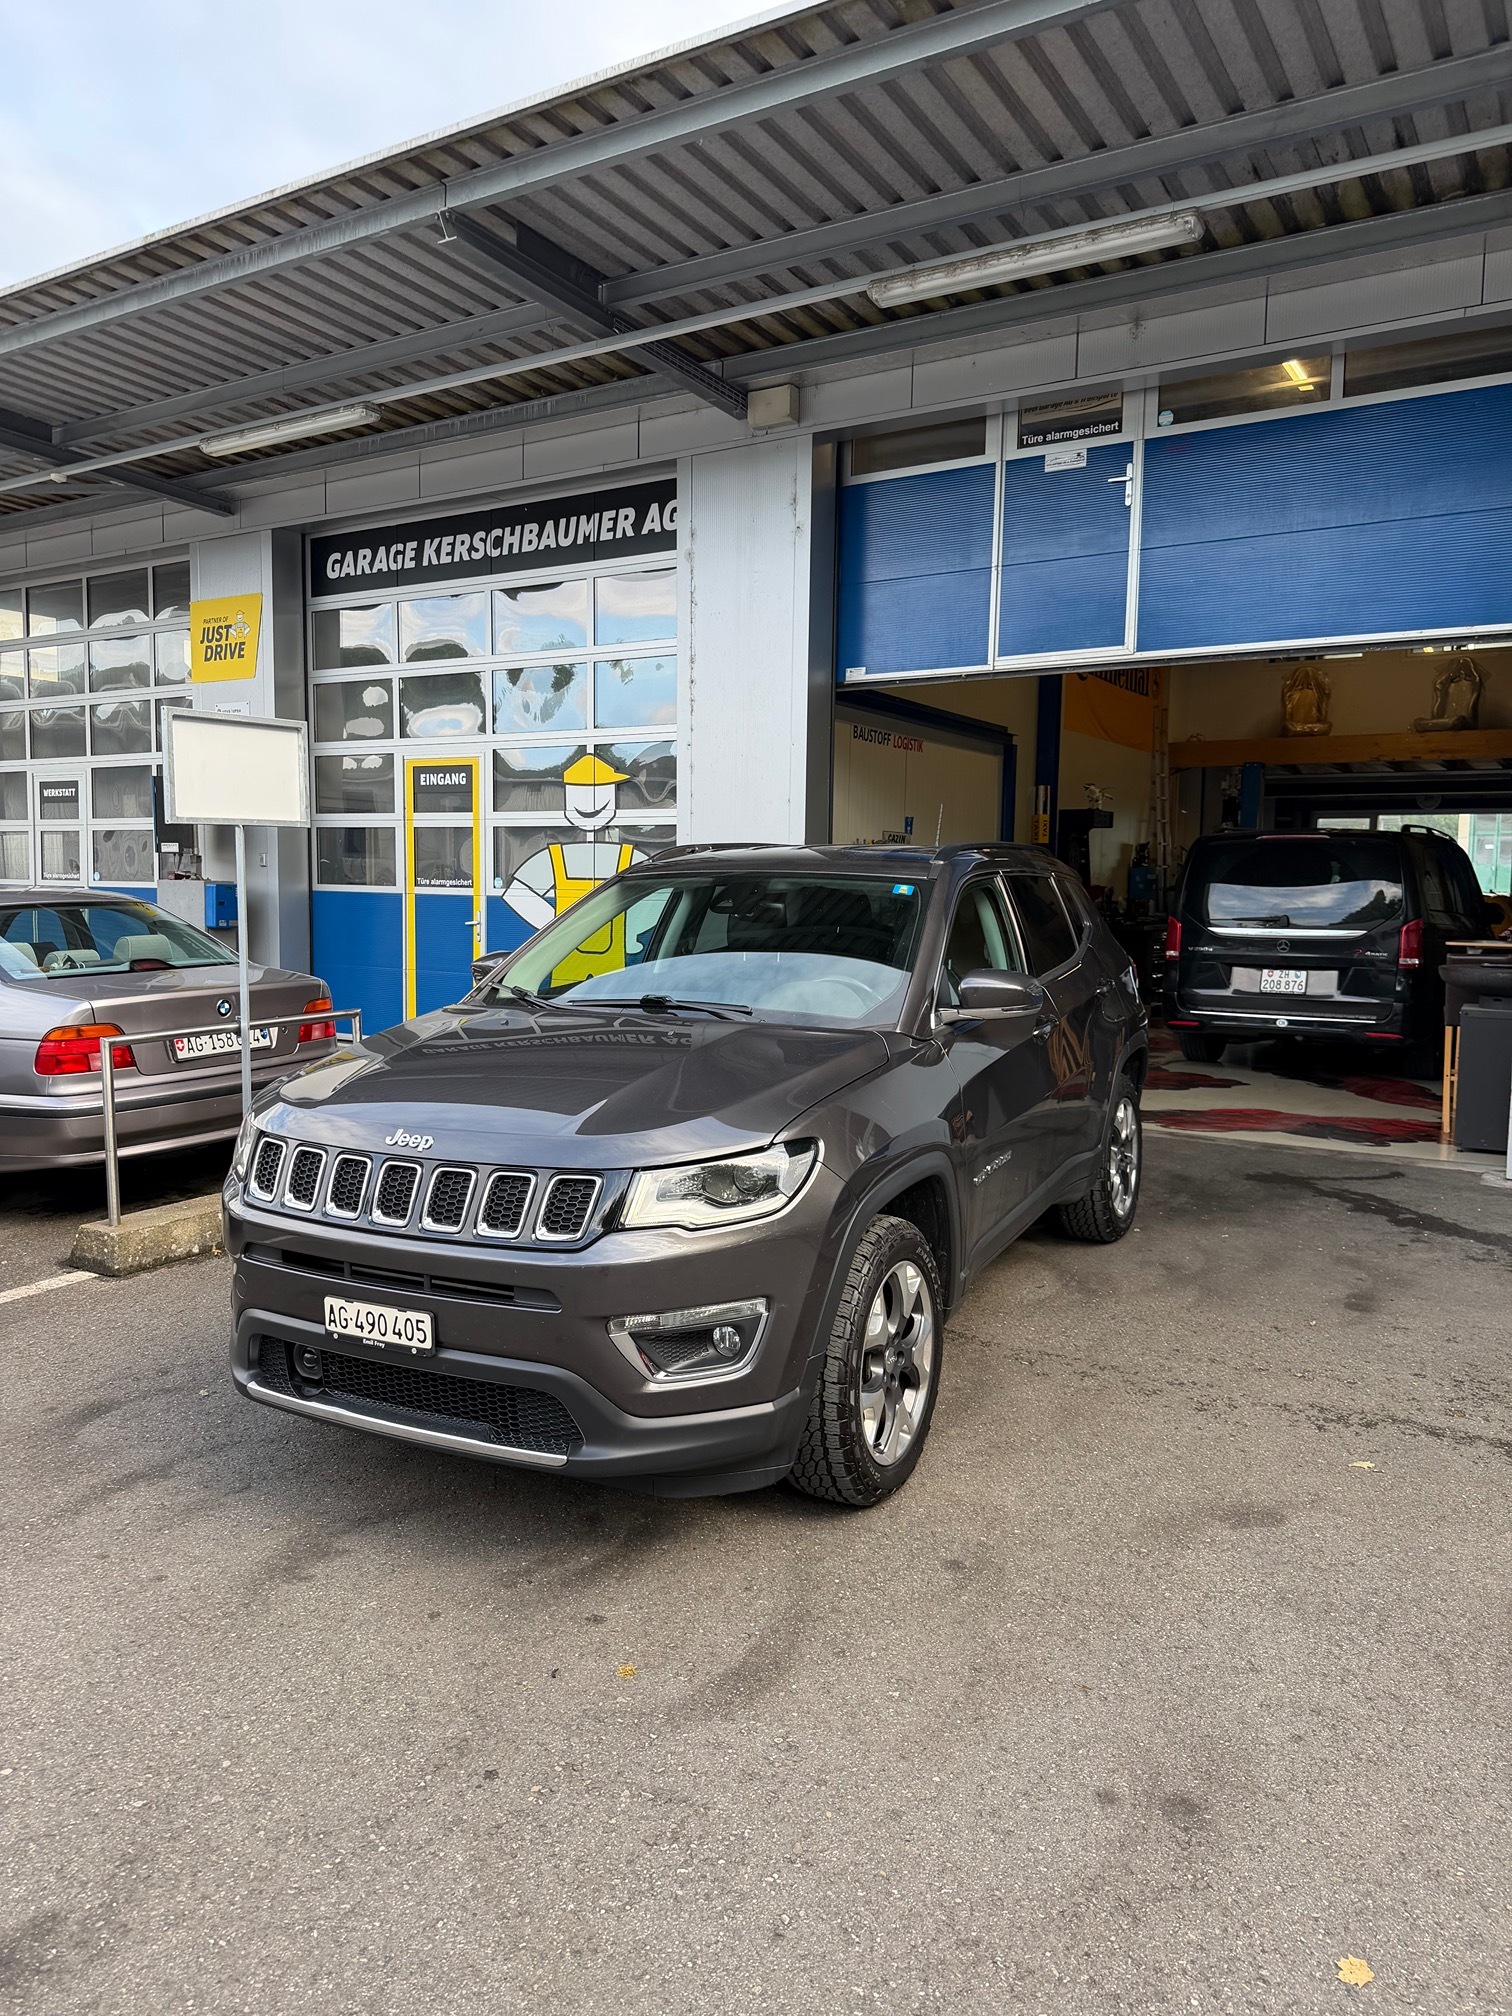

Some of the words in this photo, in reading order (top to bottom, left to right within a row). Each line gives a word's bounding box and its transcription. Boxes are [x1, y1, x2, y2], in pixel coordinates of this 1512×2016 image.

[1022, 434, 1043, 445] Türe
[1046, 421, 1119, 441] alarmgesichert
[326, 541, 418, 580] GARAGE
[422, 507, 636, 567] KERSCHBAUMER
[641, 499, 677, 535] AG
[203, 617, 221, 625] PARTNER
[222, 615, 229, 623] OF
[200, 624, 232, 645] JUST
[204, 641, 246, 662] DRIVE
[853, 725, 891, 746] BAUSTOFF
[893, 735, 924, 753] LOGISTIK
[420, 773, 466, 785] EINGANG
[43, 788, 76, 797] WERKSTATT
[417, 877, 430, 885] Türe
[430, 878, 473, 887] alarmgesichert
[1279, 970, 1290, 979] ZH
[1262, 979, 1282, 990] 208
[1284, 980, 1304, 991] 876
[385, 1128, 435, 1152] Jeep
[392, 1315, 427, 1344] 405
[362, 1338, 374, 1347] Emil
